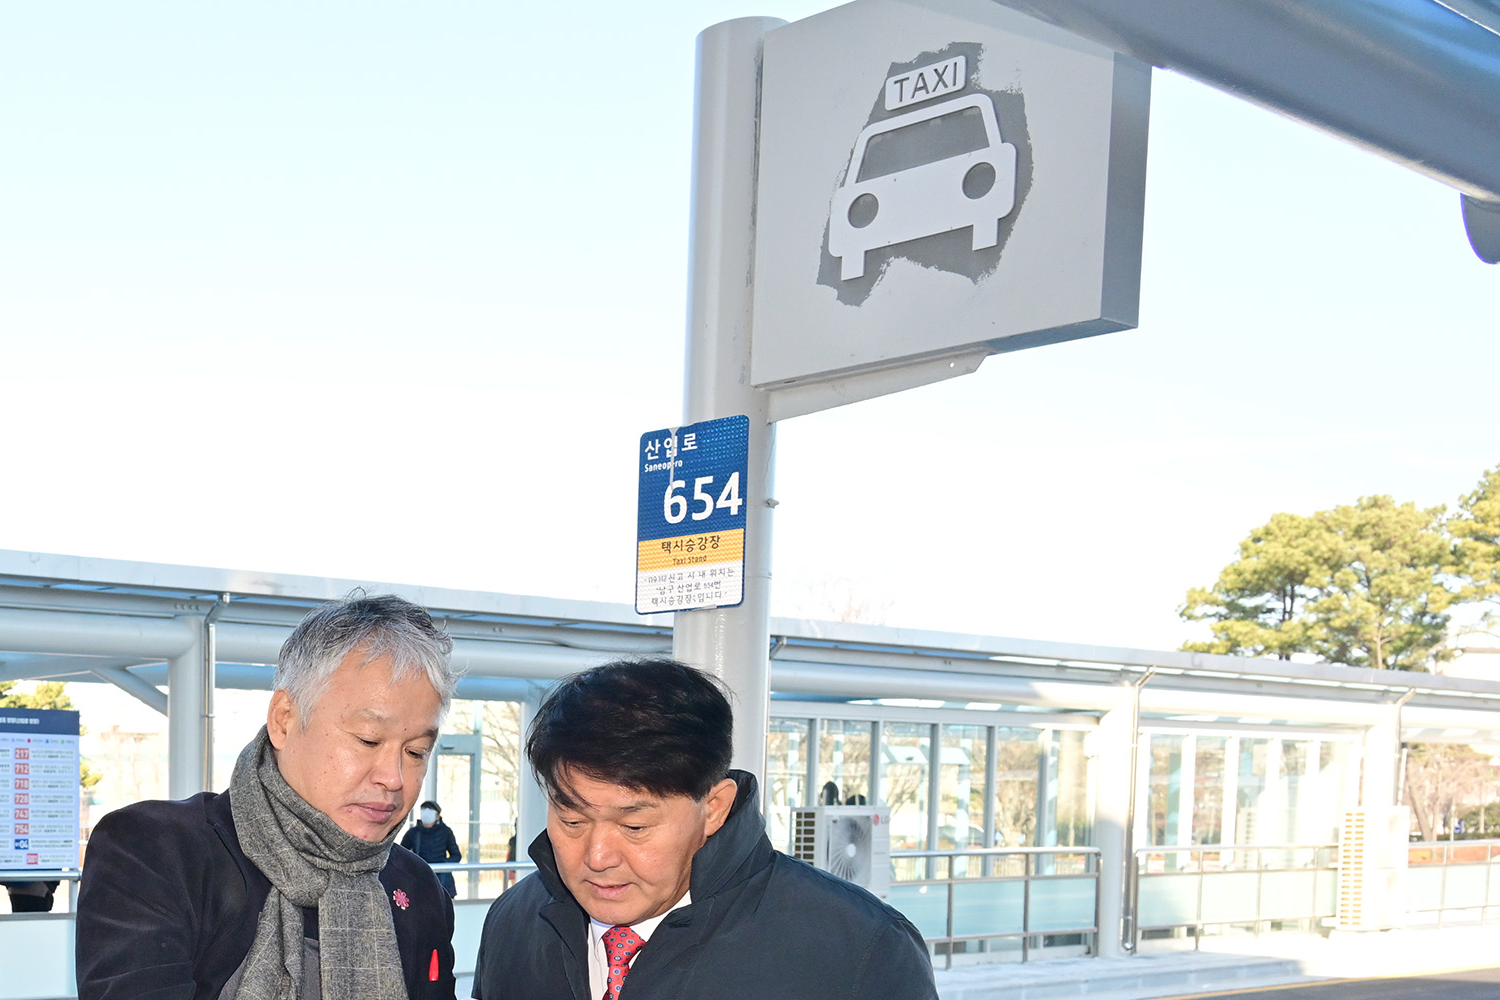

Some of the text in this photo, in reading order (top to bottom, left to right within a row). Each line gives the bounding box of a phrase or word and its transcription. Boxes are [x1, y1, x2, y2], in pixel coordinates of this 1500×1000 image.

[893, 62, 958, 103] TAXI
[645, 433, 698, 460] 산업로
[663, 472, 743, 524] 654
[661, 535, 720, 554] 택시승강장
[15, 749, 29, 758] 217
[15, 764, 29, 773] 712
